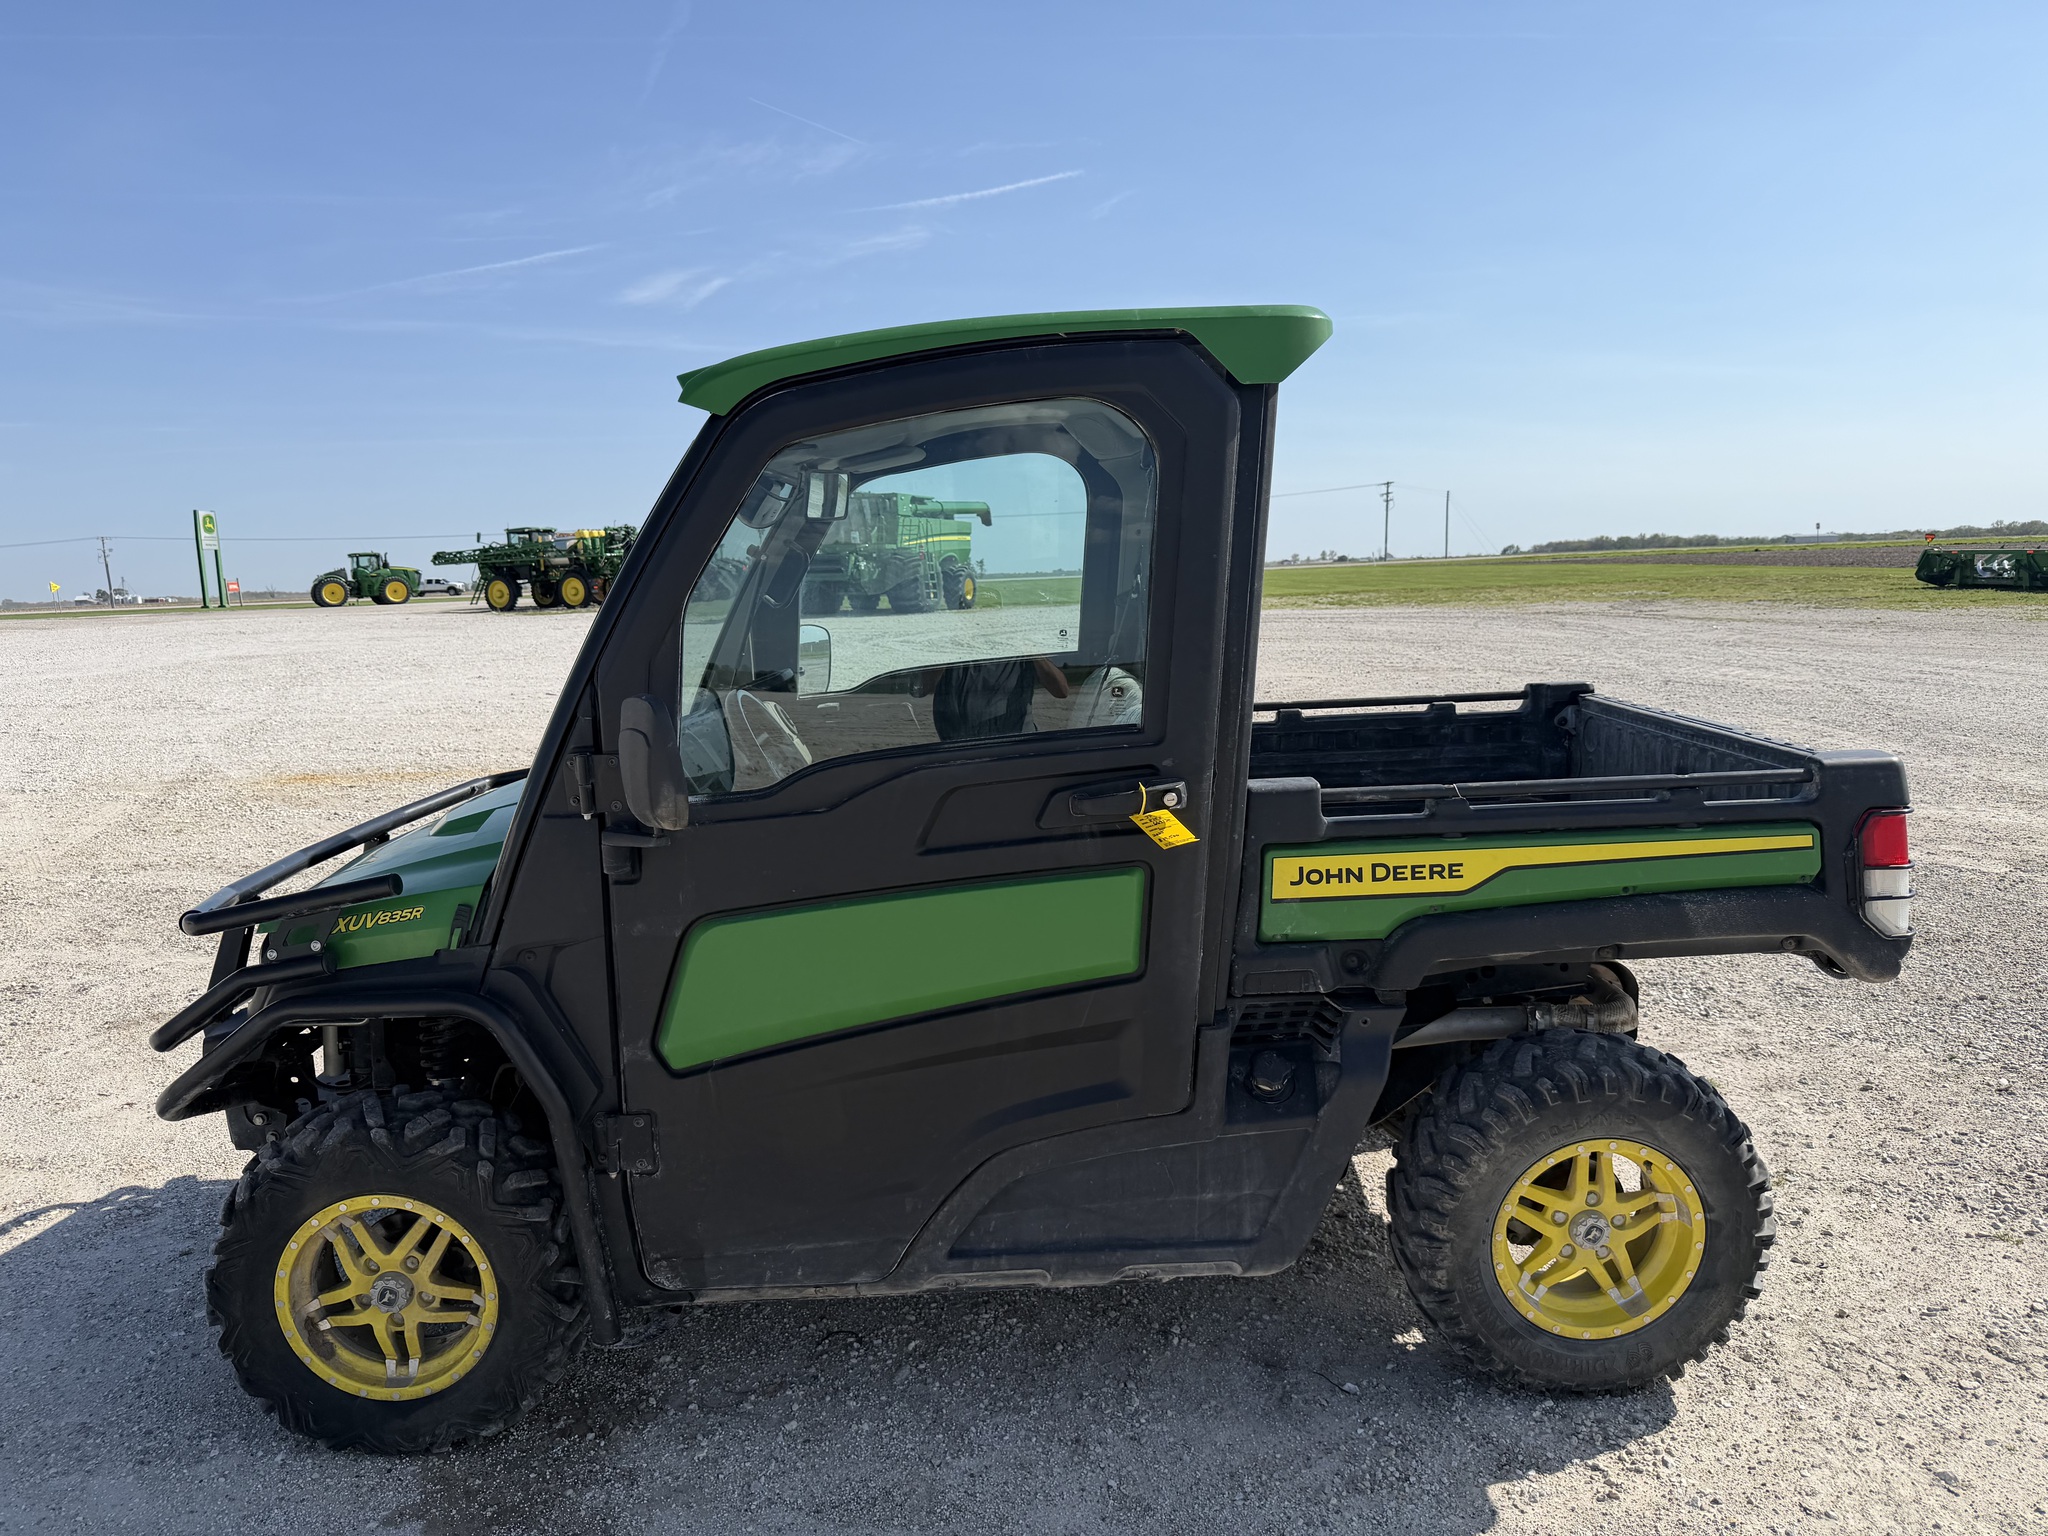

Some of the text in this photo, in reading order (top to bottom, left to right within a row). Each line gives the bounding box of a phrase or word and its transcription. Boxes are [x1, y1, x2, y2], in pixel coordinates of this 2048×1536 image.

[1289, 862, 1464, 886] JOHN DEERE
[331, 906, 425, 934] XUV835R
